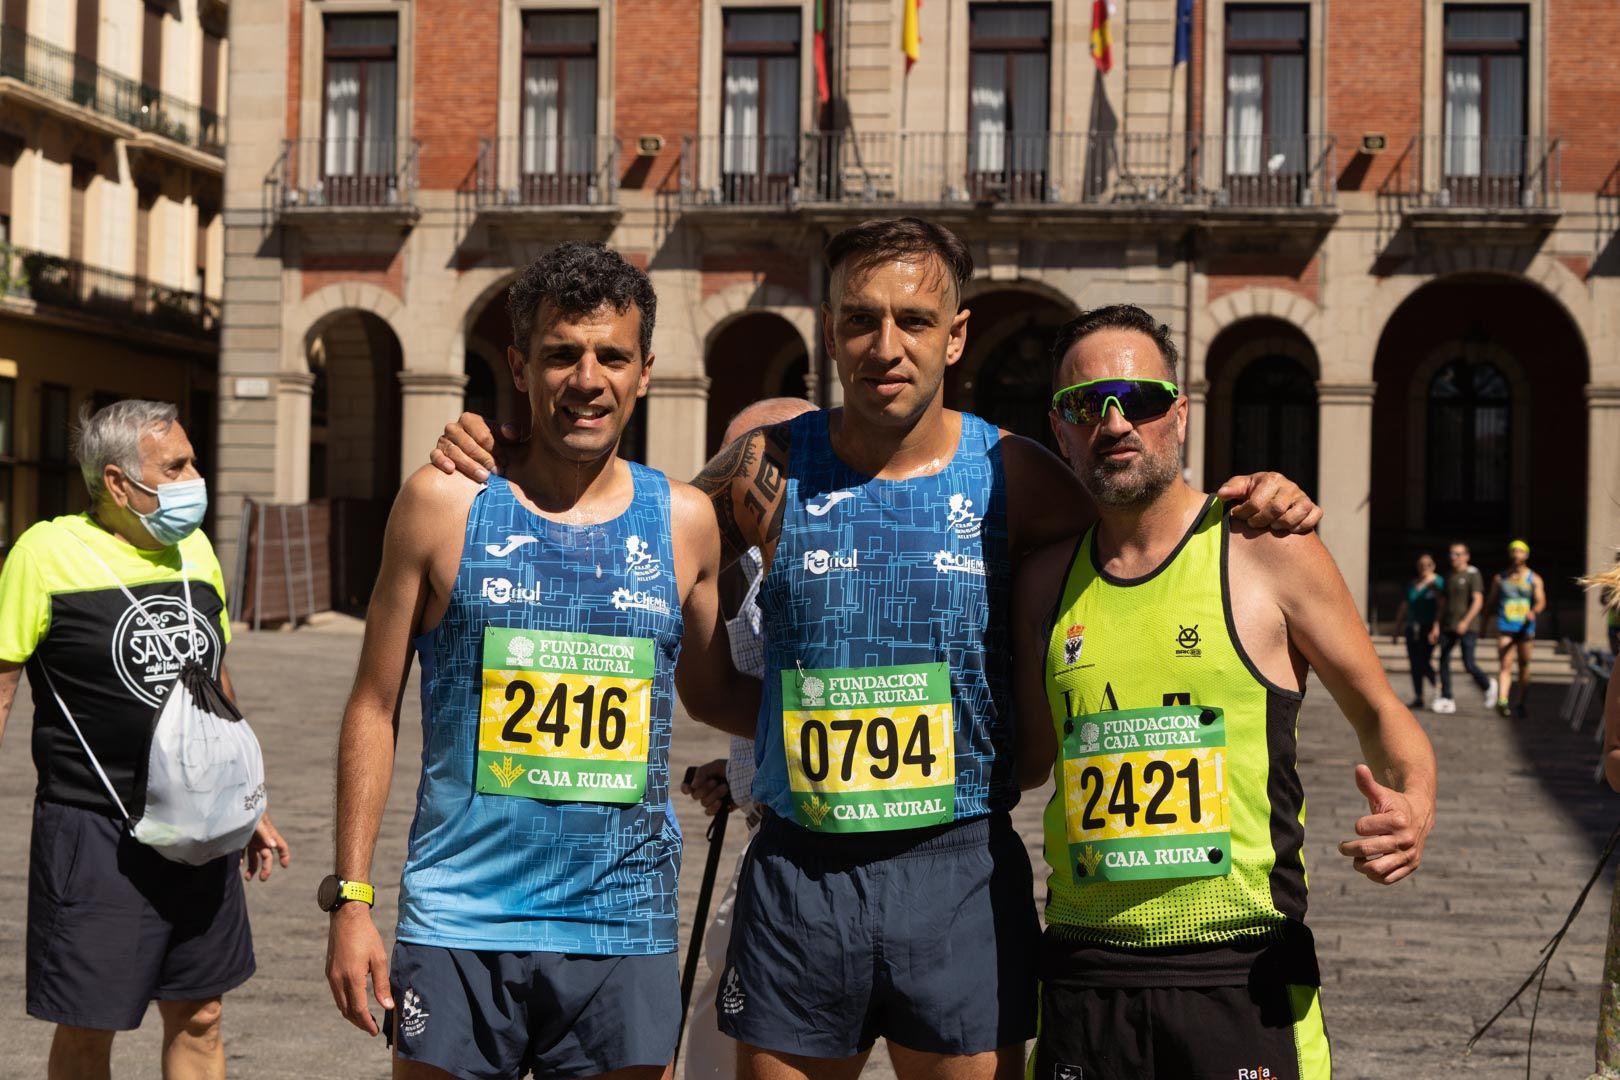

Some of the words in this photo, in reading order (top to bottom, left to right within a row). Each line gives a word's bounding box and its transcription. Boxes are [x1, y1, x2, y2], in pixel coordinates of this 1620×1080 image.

[539, 639, 635, 660] FUNDACION
[538, 654, 578, 671] CAJA
[583, 657, 634, 674] RURAL
[828, 672, 929, 691] FUNDACION
[829, 690, 870, 707] CAJA
[873, 687, 929, 704] RURAL
[501, 679, 628, 750] 2416
[1103, 714, 1201, 735] FUNDACION
[800, 714, 937, 782] 0794
[1103, 733, 1141, 750] CAJA
[1143, 730, 1201, 747] RURAL
[527, 768, 573, 787] CAJA
[577, 771, 638, 790] RURAL
[1080, 757, 1202, 830] 2421
[833, 802, 880, 820] CAJA
[883, 798, 947, 818] RURAL
[1105, 850, 1151, 868] CAJA
[1238, 1066, 1271, 1080] Rafa
